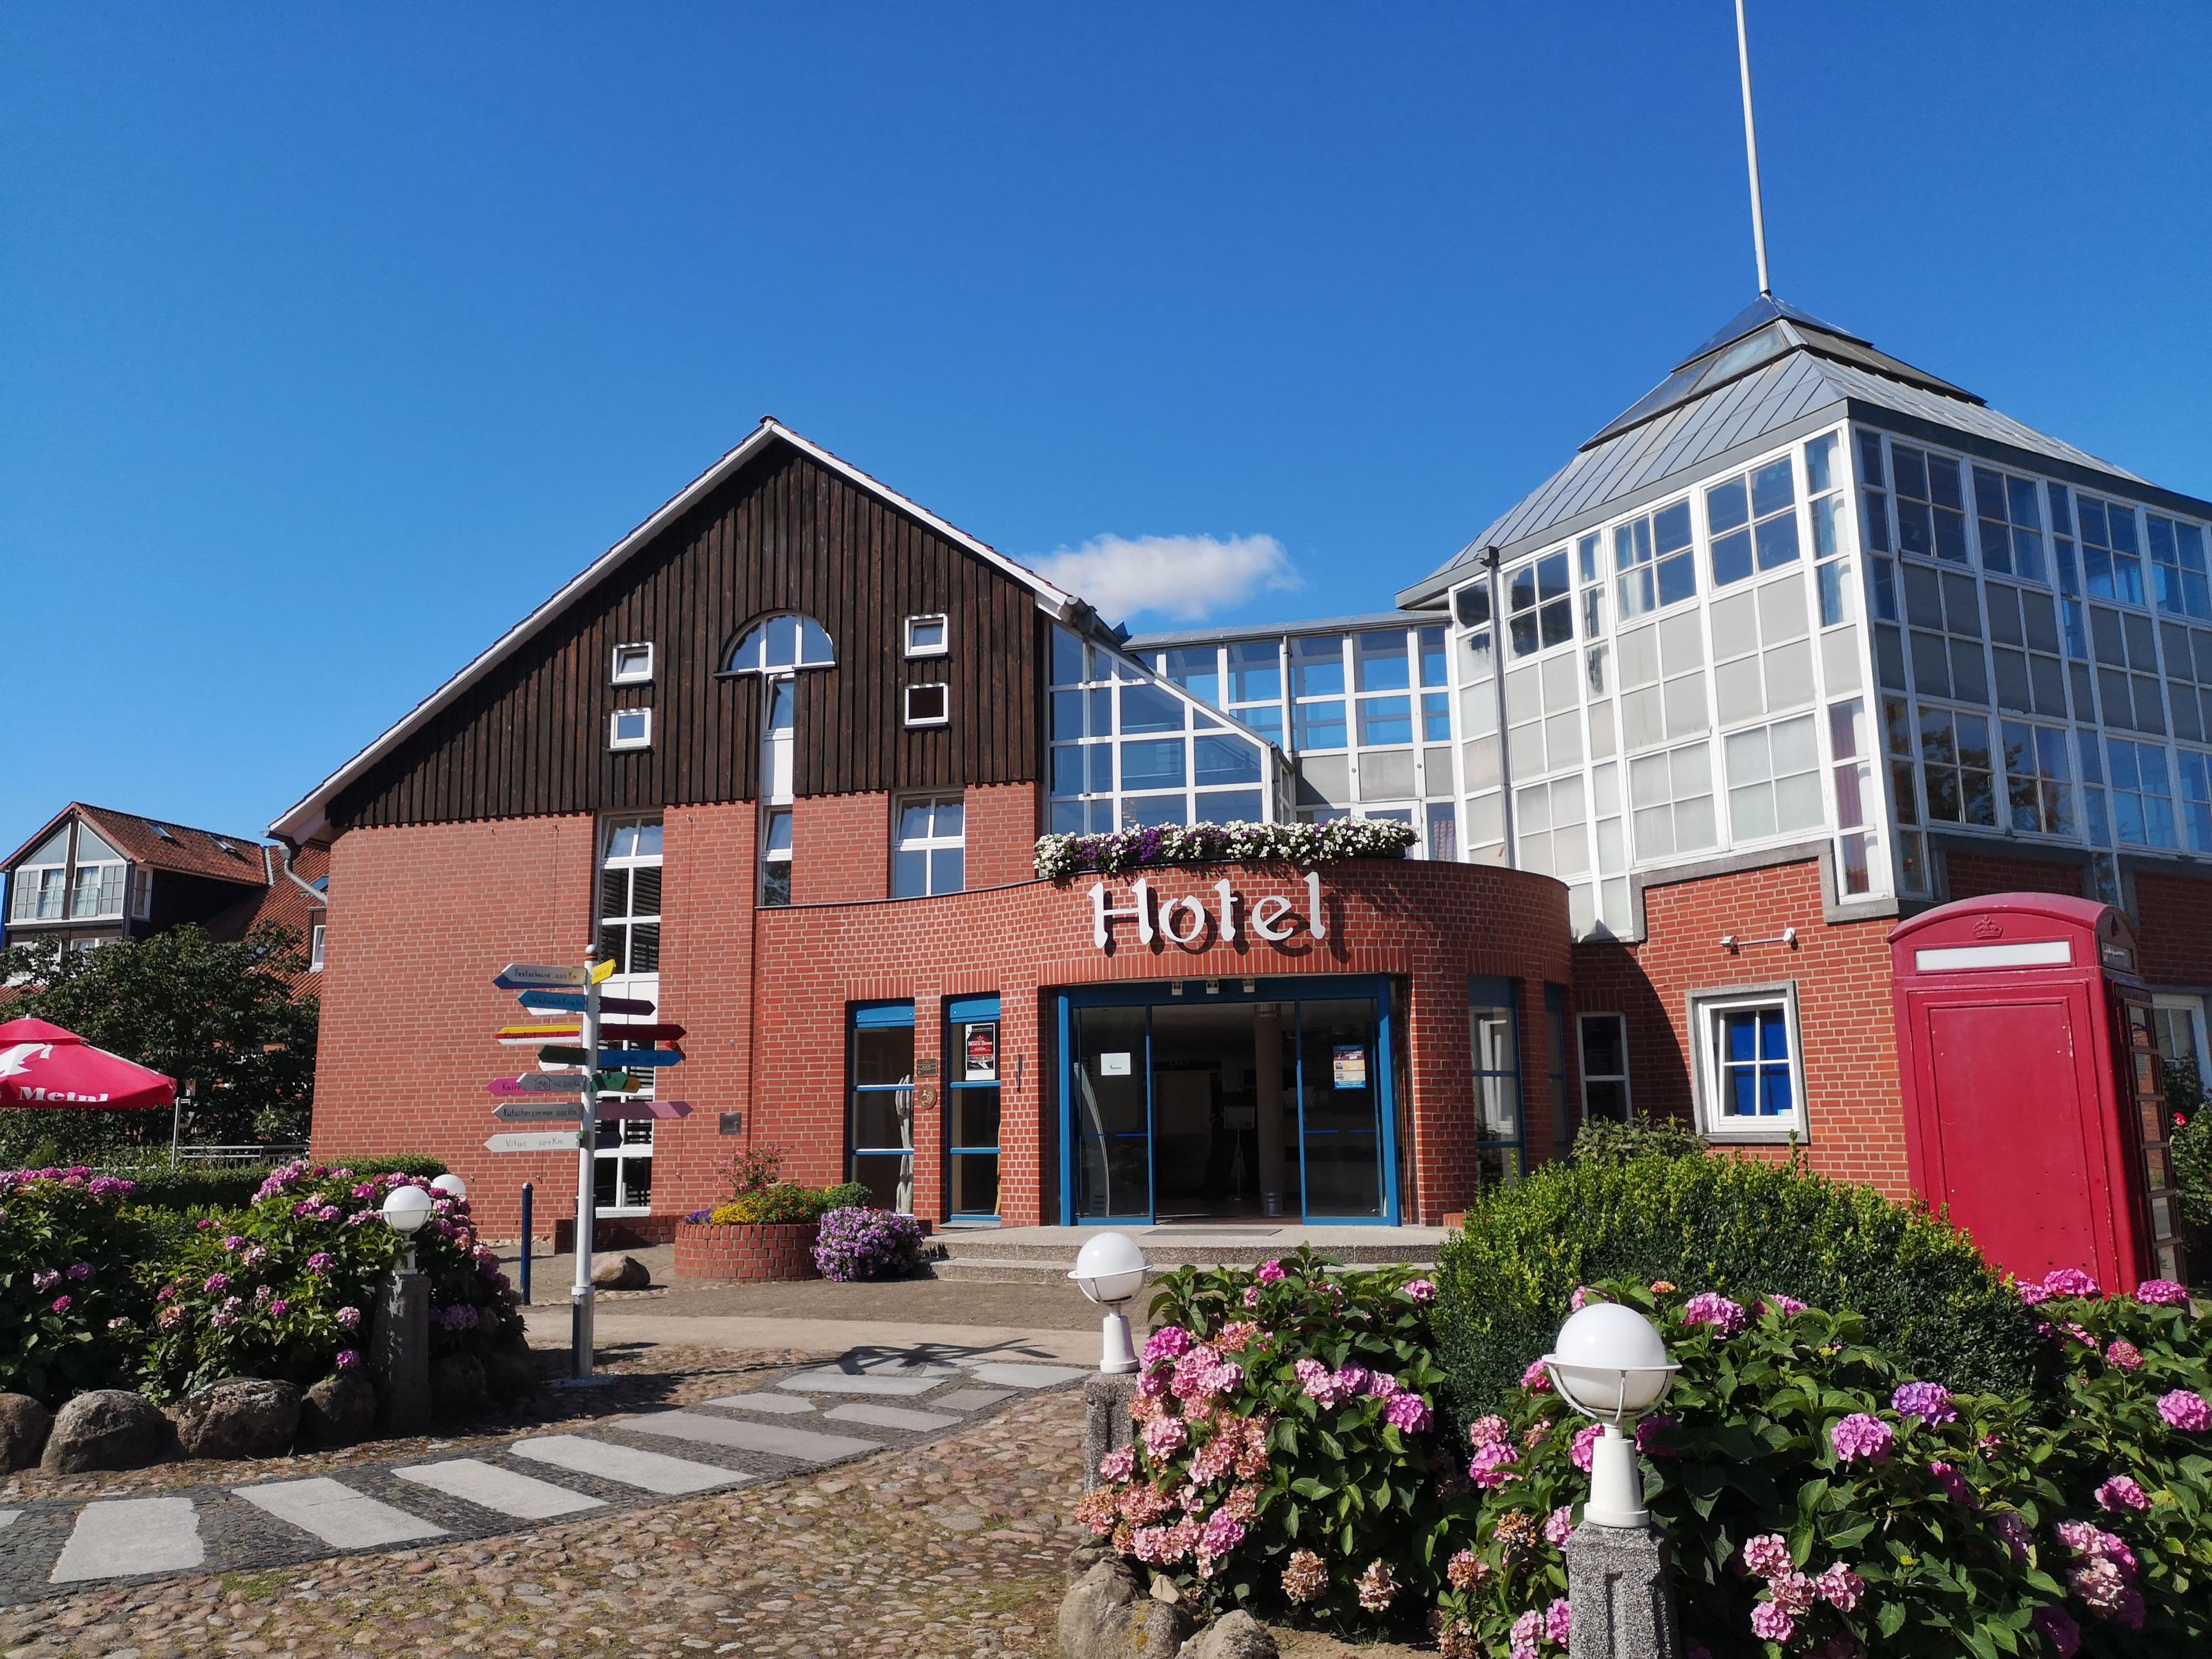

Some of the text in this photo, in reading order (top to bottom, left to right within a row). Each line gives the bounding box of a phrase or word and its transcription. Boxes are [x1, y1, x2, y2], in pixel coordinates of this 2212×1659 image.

[1088, 871, 1325, 948] Hotel
[18, 1086, 109, 1102] Meinl
[503, 1108, 553, 1116] Kutscherzimmer
[506, 1139, 527, 1147] Vitus
